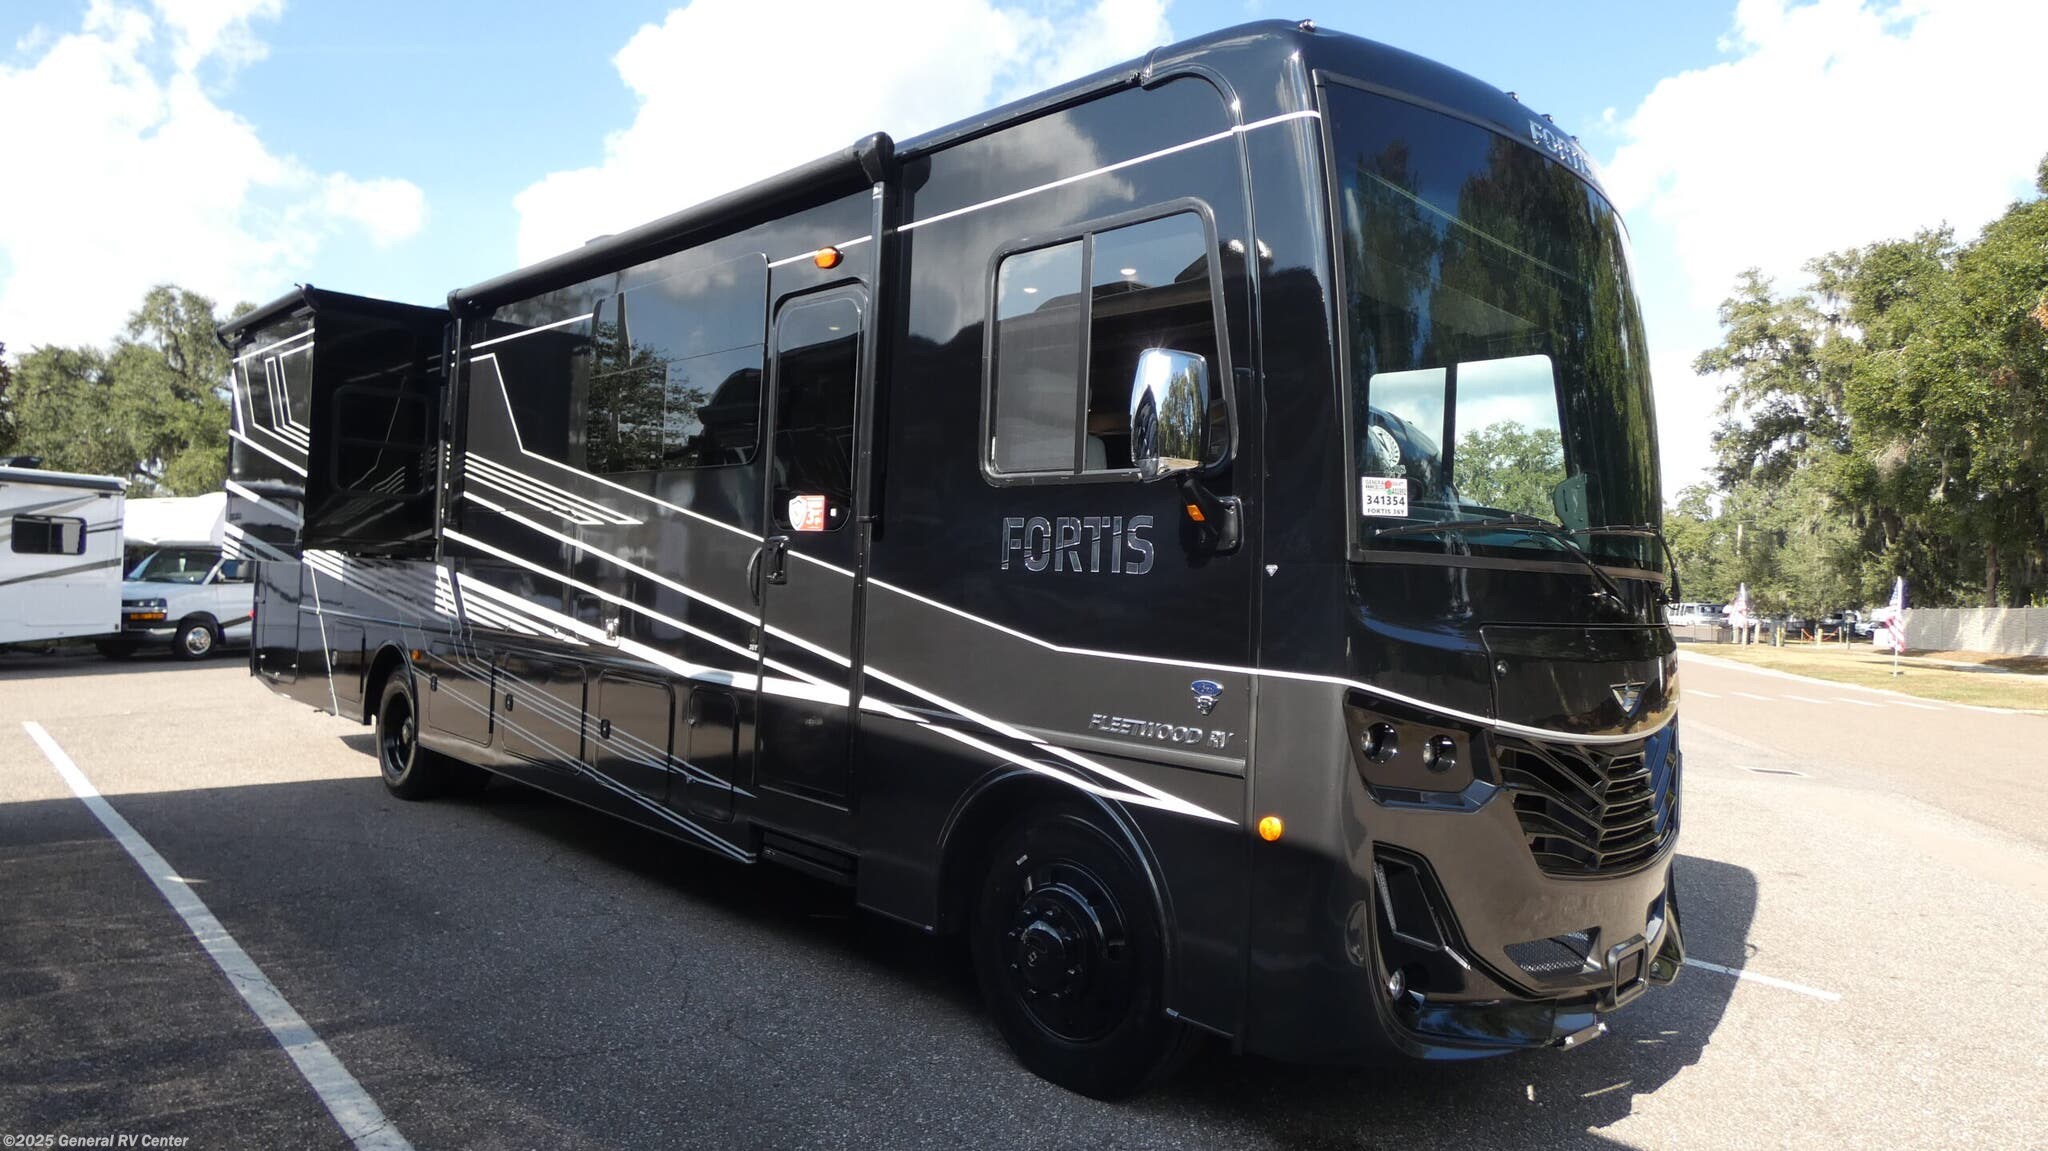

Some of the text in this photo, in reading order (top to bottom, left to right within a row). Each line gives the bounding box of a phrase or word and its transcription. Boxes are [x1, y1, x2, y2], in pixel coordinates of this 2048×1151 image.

[1528, 119, 1595, 182] FORTIS
[1366, 495, 1405, 506] 341354
[1001, 515, 1155, 575] FORTIS
[1088, 713, 1235, 750] FLEETWOOD RV
